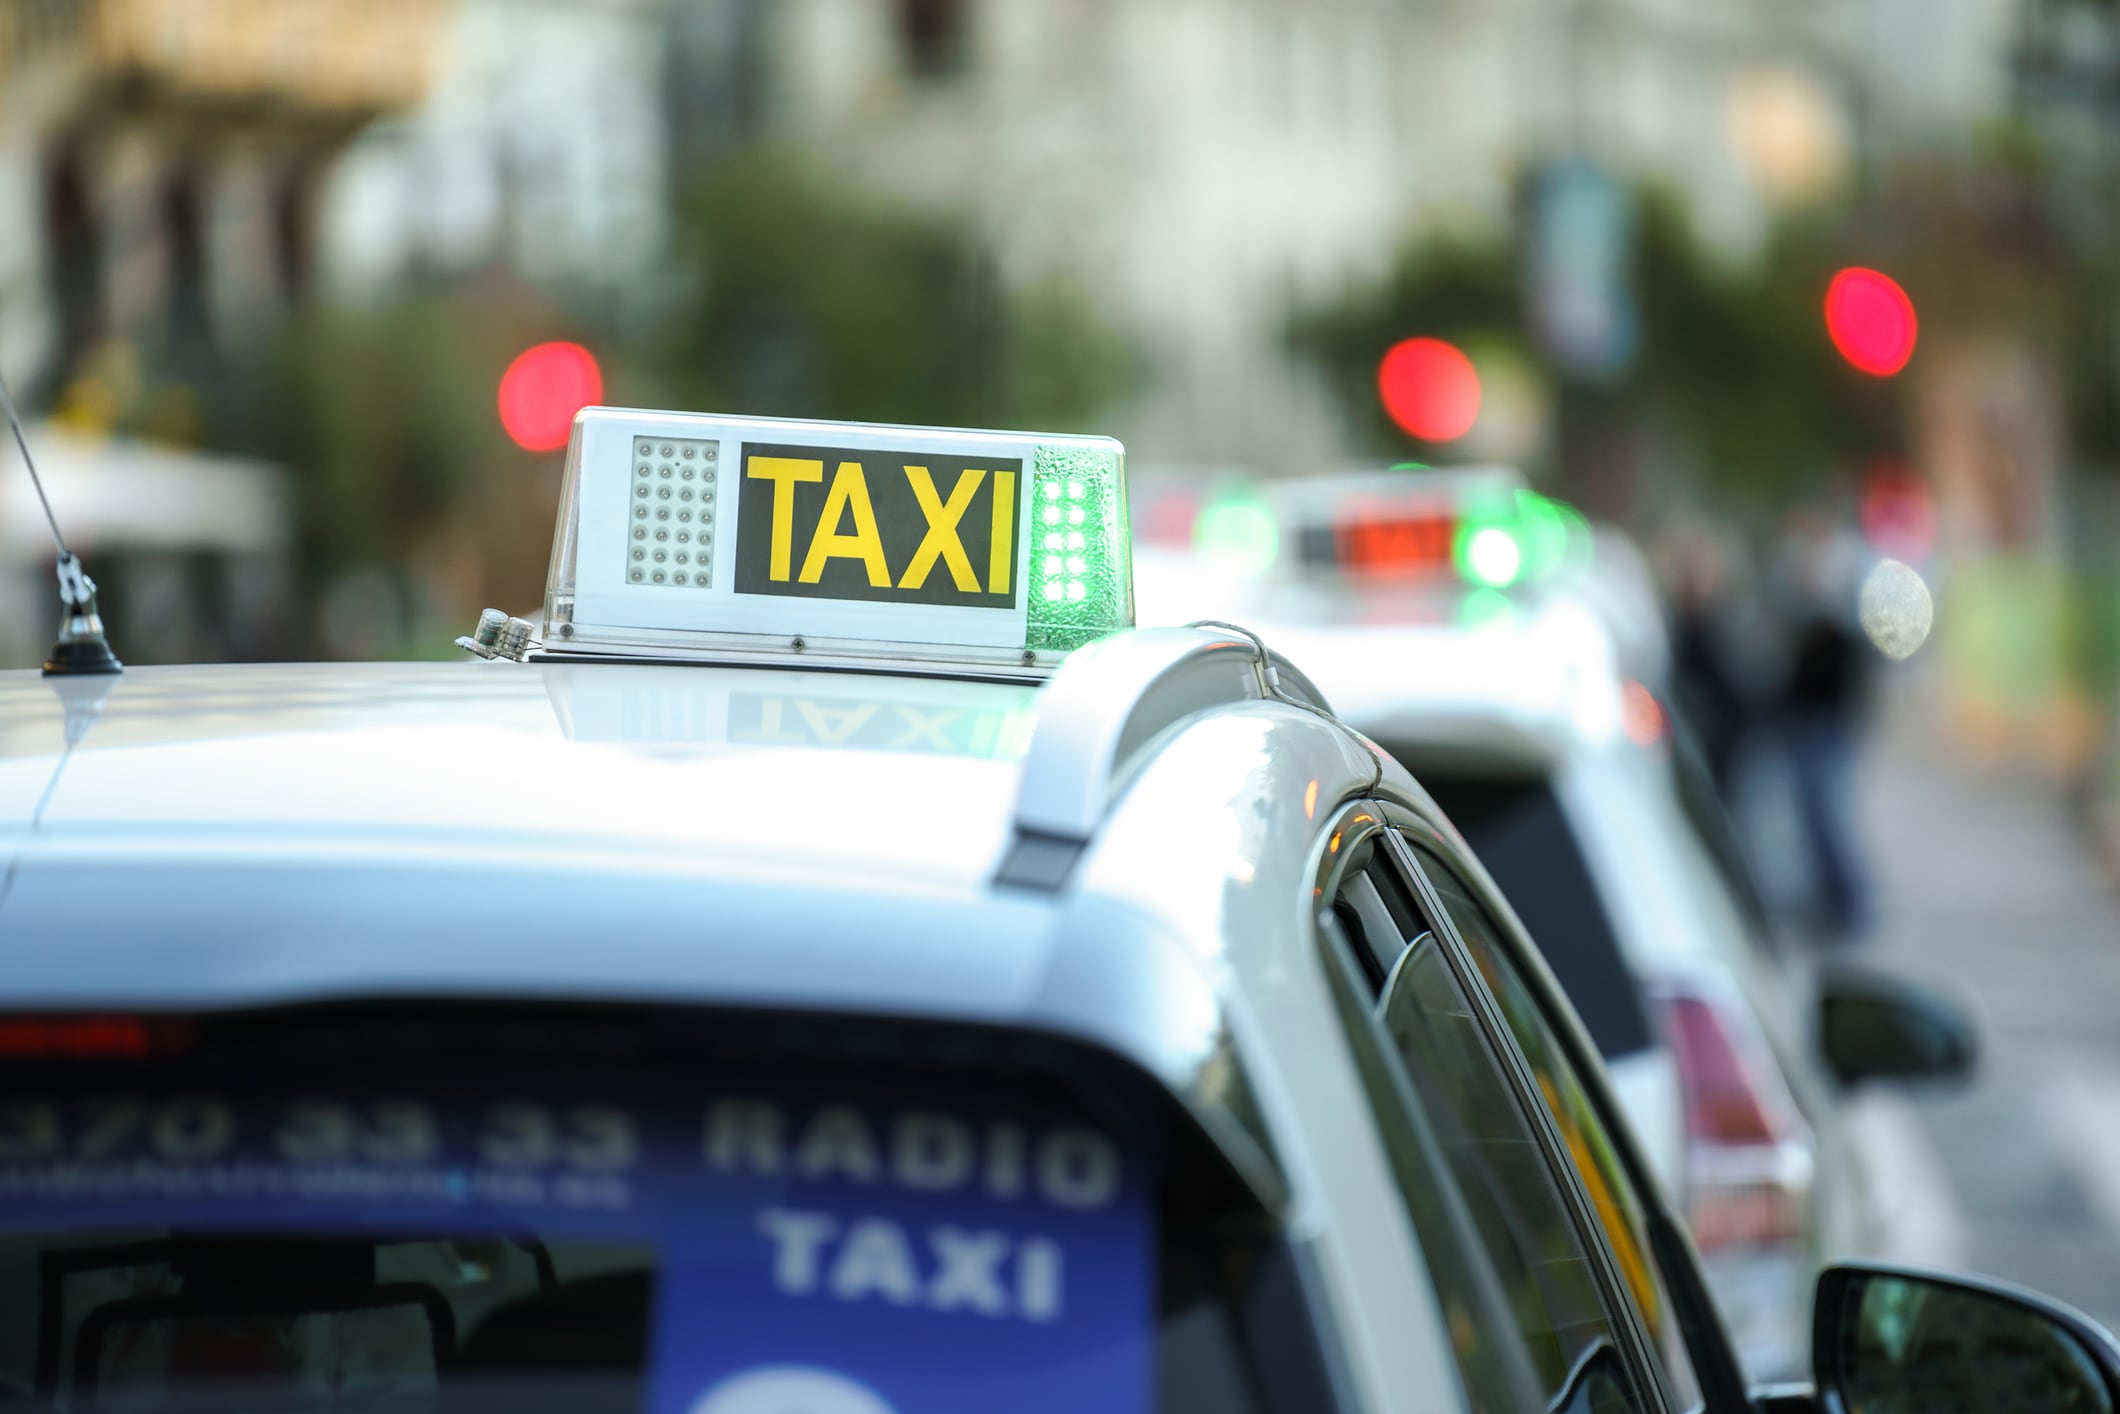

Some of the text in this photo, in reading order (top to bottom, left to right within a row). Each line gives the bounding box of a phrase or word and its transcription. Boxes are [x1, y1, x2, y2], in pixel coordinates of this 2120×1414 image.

[747, 455, 1016, 595] TAXI
[276, 1100, 438, 1165] 33
[479, 1102, 638, 1172] 33
[705, 1096, 1119, 1209] RADIO
[757, 1207, 1065, 1323] TAXI
